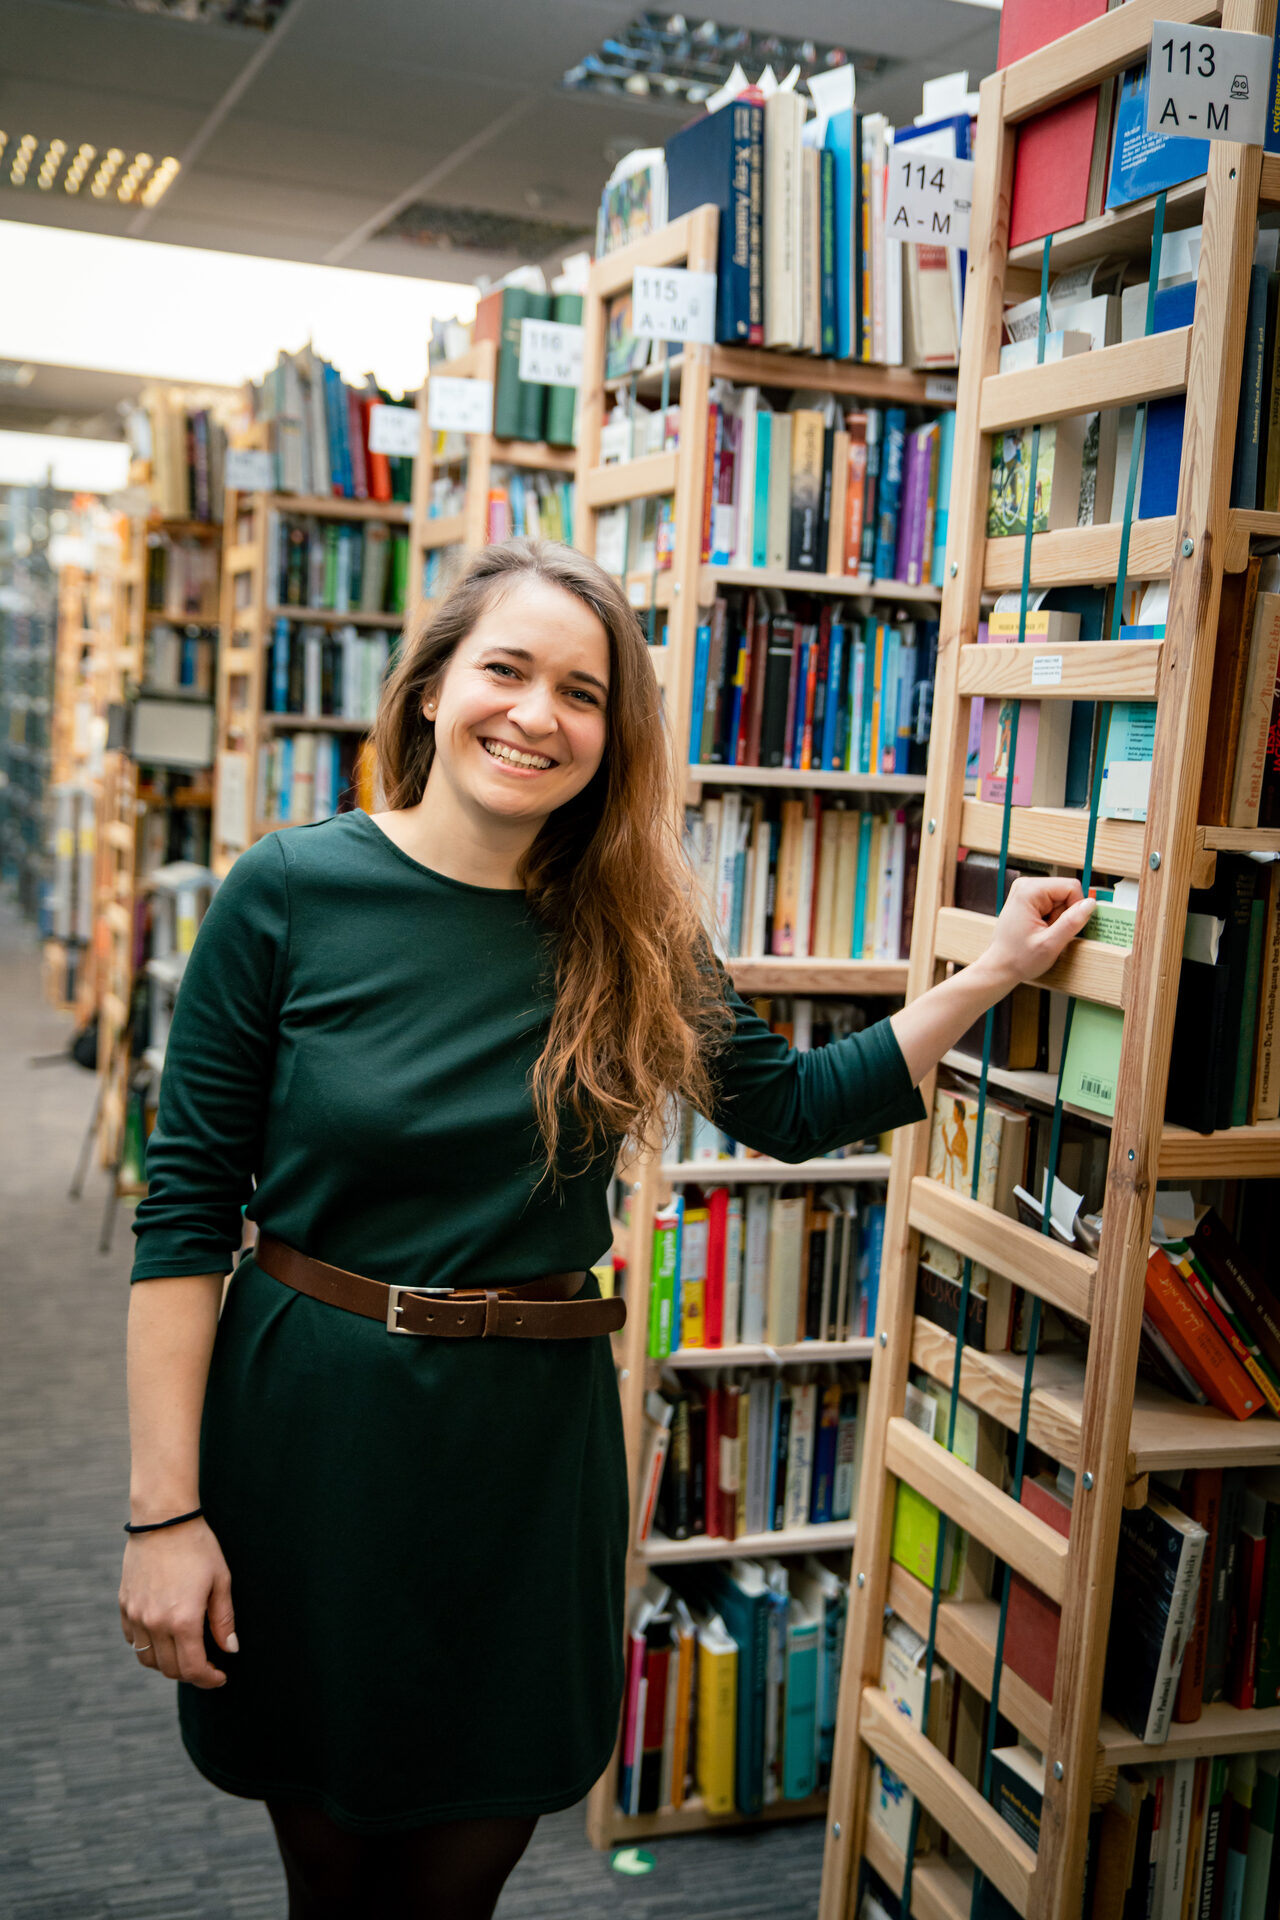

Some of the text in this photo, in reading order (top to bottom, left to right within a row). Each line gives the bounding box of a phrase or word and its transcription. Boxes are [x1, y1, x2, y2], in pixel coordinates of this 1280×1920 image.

[1162, 38, 1216, 78] 113
[1159, 97, 1180, 127] A
[1206, 101, 1230, 131] M
[901, 161, 946, 194] 114
[893, 206, 911, 228] A
[932, 211, 952, 235] M
[642, 278, 679, 302] 115
[640, 311, 654, 330] A
[1266, 724, 1277, 755] LISA
[659, 1231, 677, 1277] Egypte
[1201, 1810, 1221, 1920] OJEKTOVÝ MANAŽER
